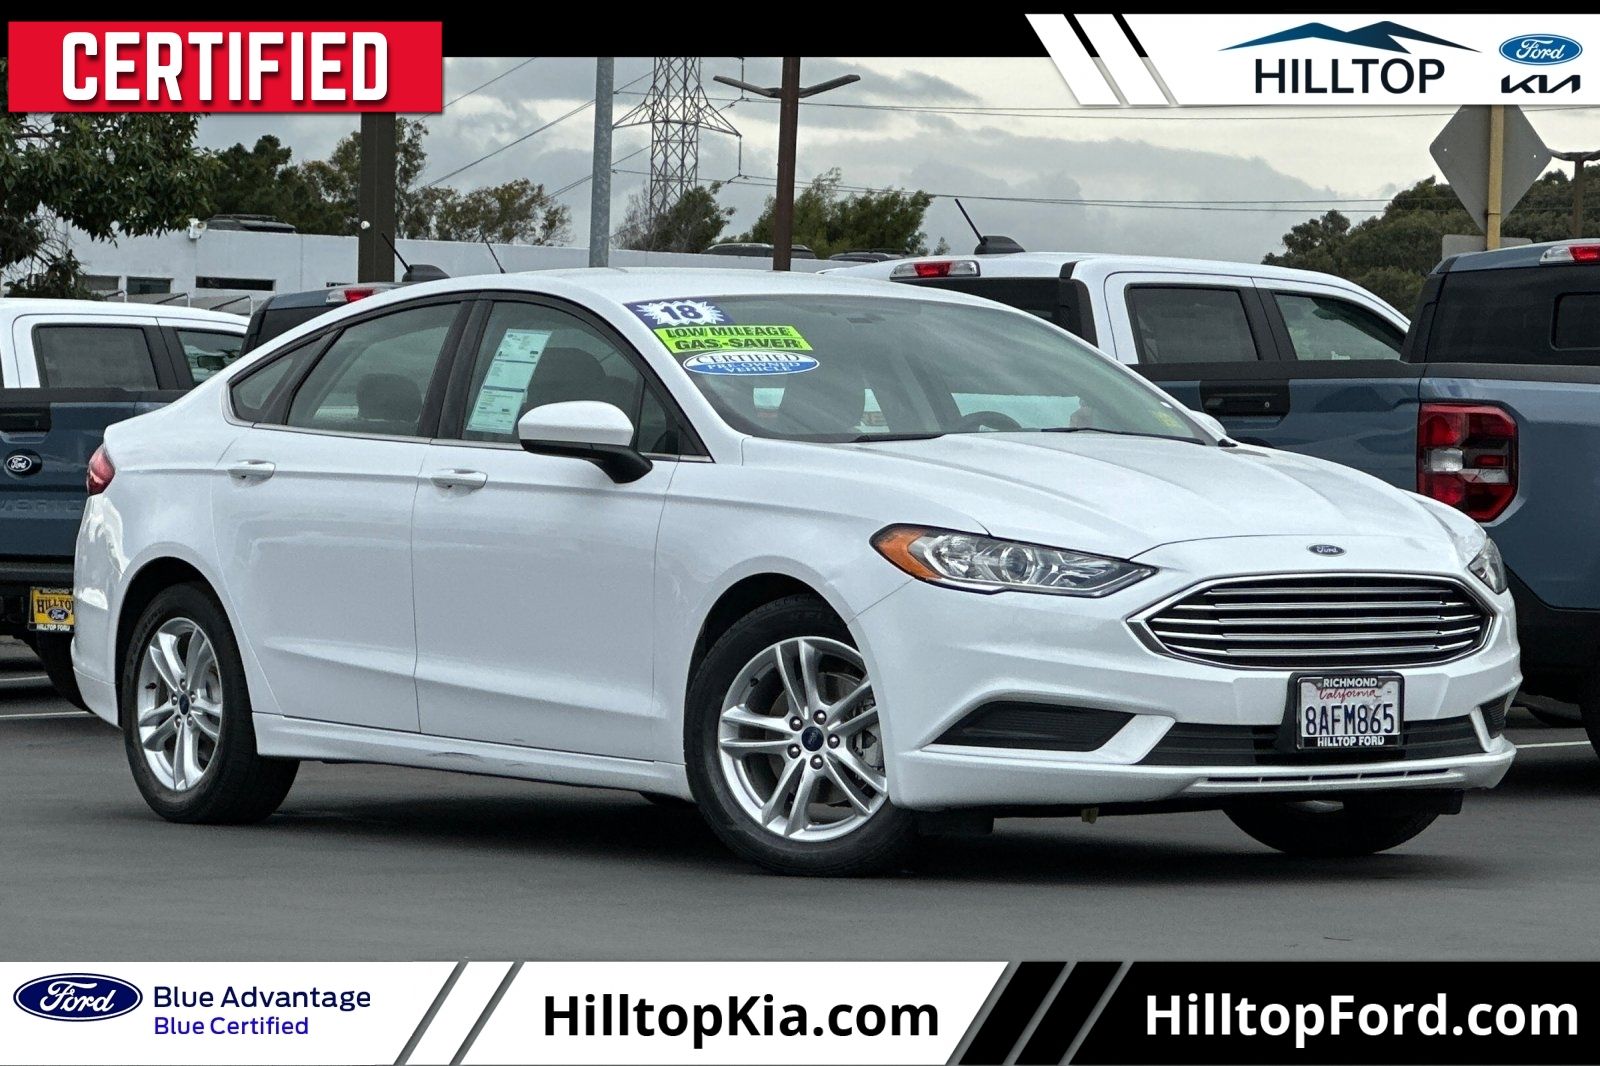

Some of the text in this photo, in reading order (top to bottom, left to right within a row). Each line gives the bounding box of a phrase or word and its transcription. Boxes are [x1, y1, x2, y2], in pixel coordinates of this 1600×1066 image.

[661, 304, 703, 321] 18
[666, 326, 791, 338] LOW MILEAGE
[674, 338, 803, 350] GAS-SAVER
[696, 354, 800, 364] CERTIFIED
[1323, 678, 1378, 688] RICHMOND
[1319, 688, 1382, 703] California
[1305, 703, 1395, 736] 8AFM865
[1317, 735, 1385, 747] HILLTOP FORD
